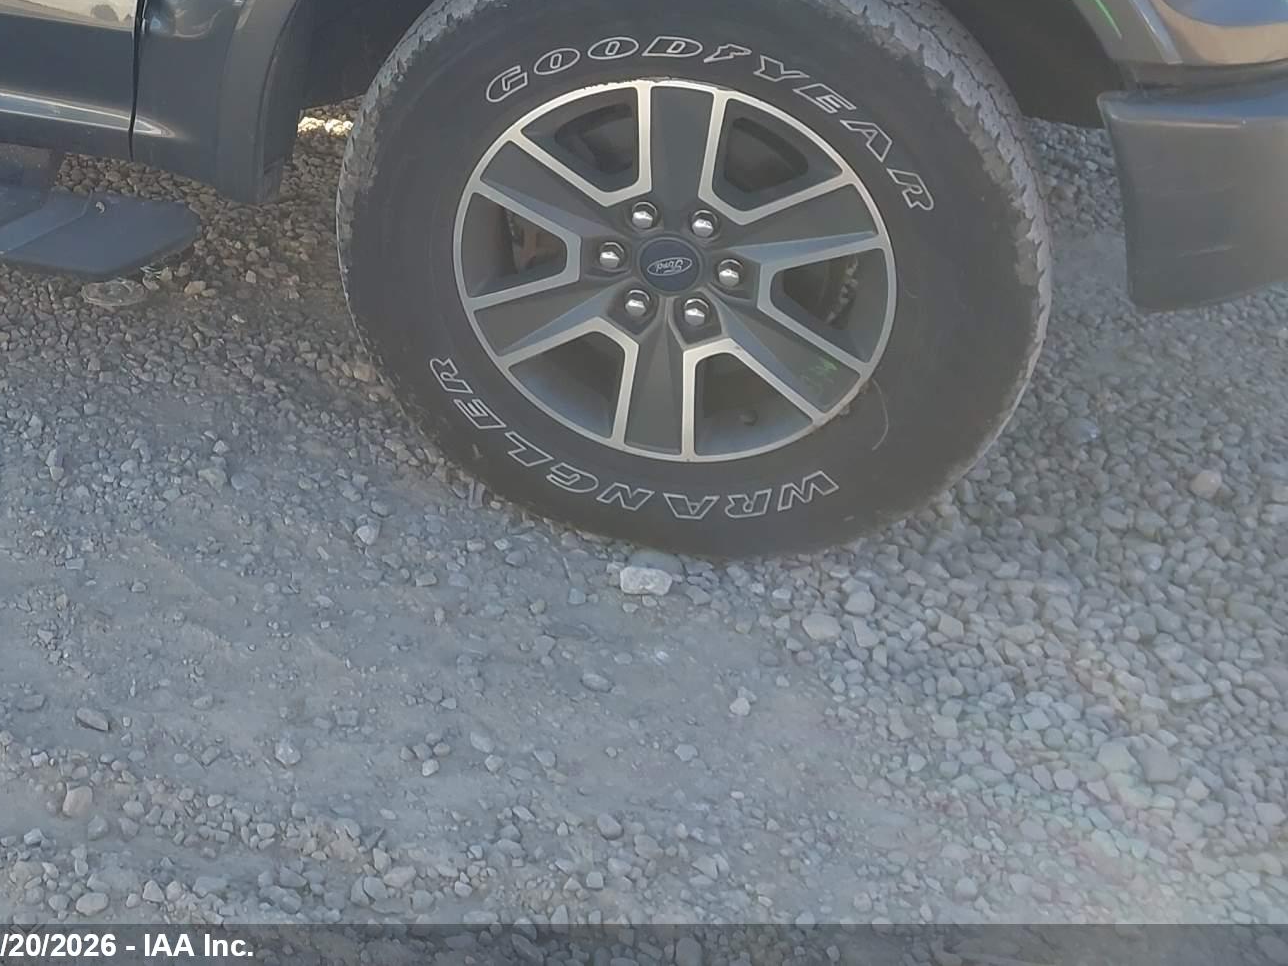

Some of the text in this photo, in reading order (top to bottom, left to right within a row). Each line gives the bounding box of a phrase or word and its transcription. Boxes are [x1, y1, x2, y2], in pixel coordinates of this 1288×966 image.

[486, 35, 935, 211] GOODYEAR
[652, 258, 687, 275] Ford
[429, 357, 840, 520] WRANGLER
